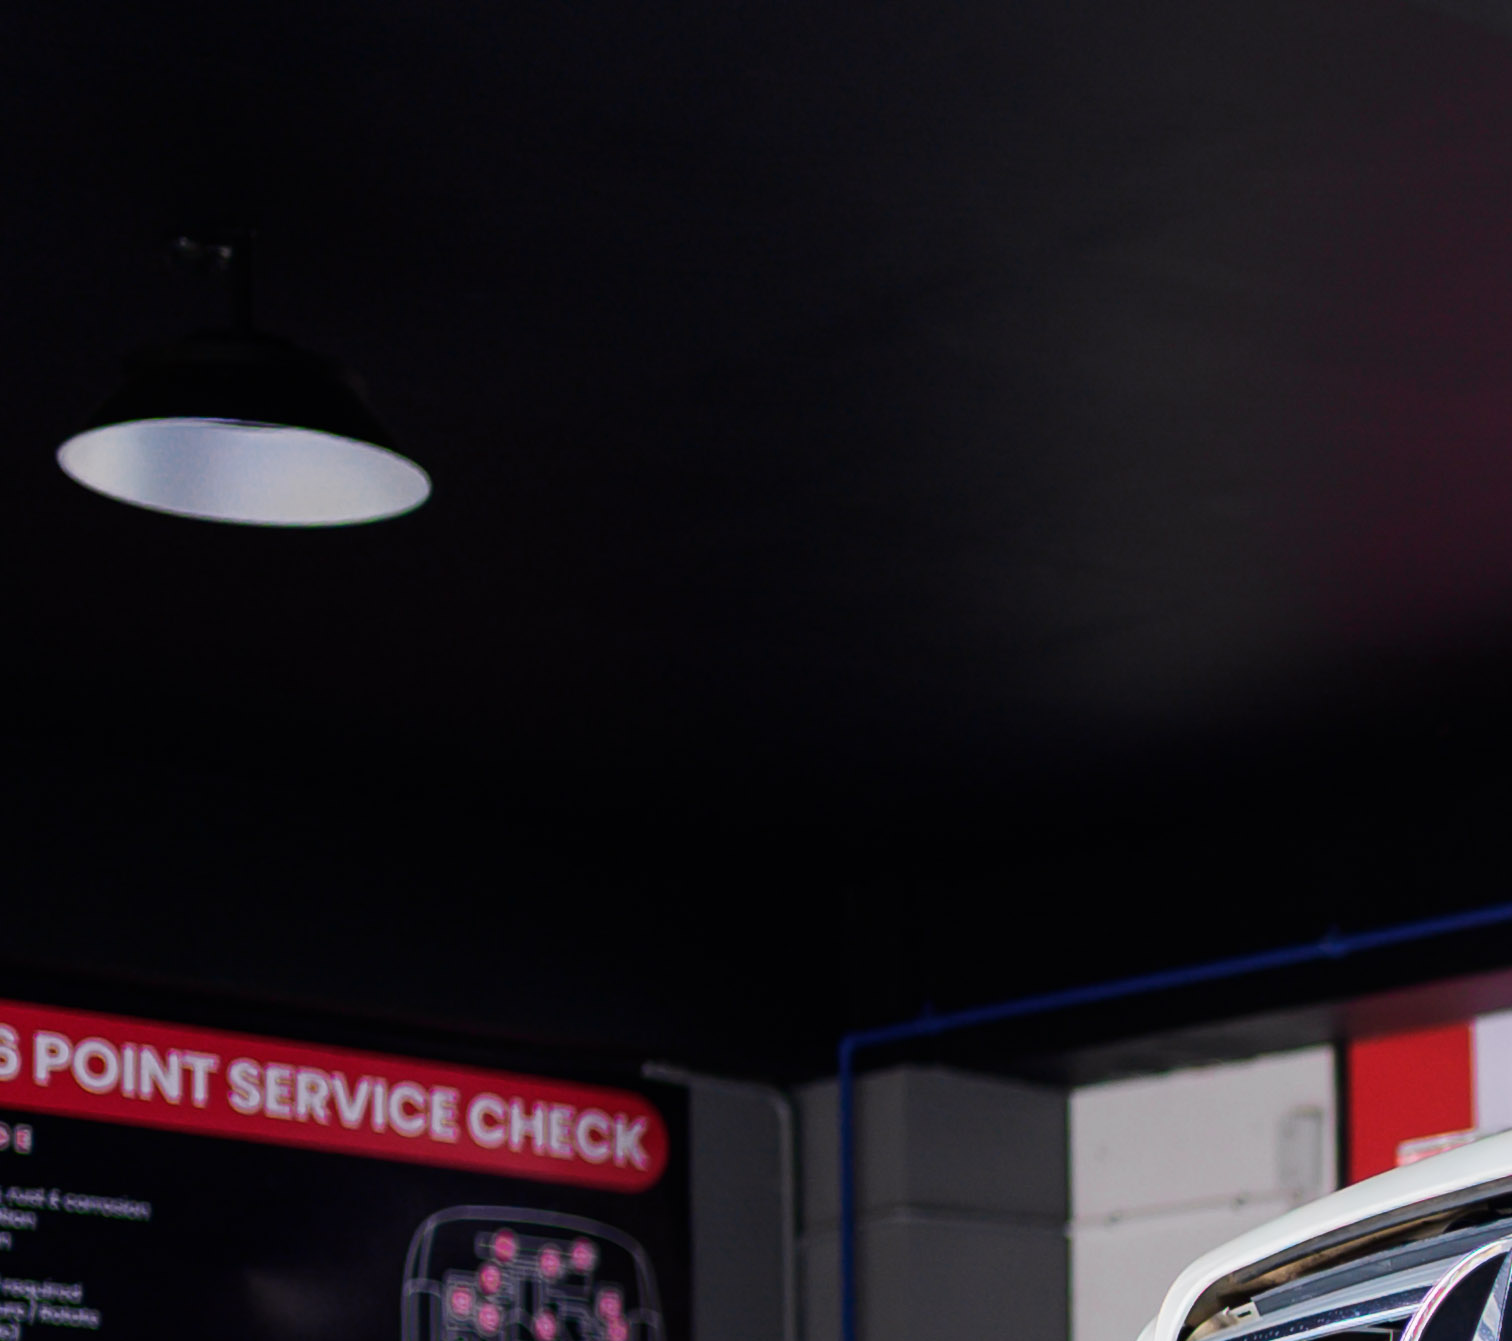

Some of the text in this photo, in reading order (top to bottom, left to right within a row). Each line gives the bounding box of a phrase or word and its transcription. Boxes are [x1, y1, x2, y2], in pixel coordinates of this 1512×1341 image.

[33, 1030, 220, 1108] POINT
[227, 1057, 461, 1144] SERVICE
[467, 1092, 649, 1171] CHECK
